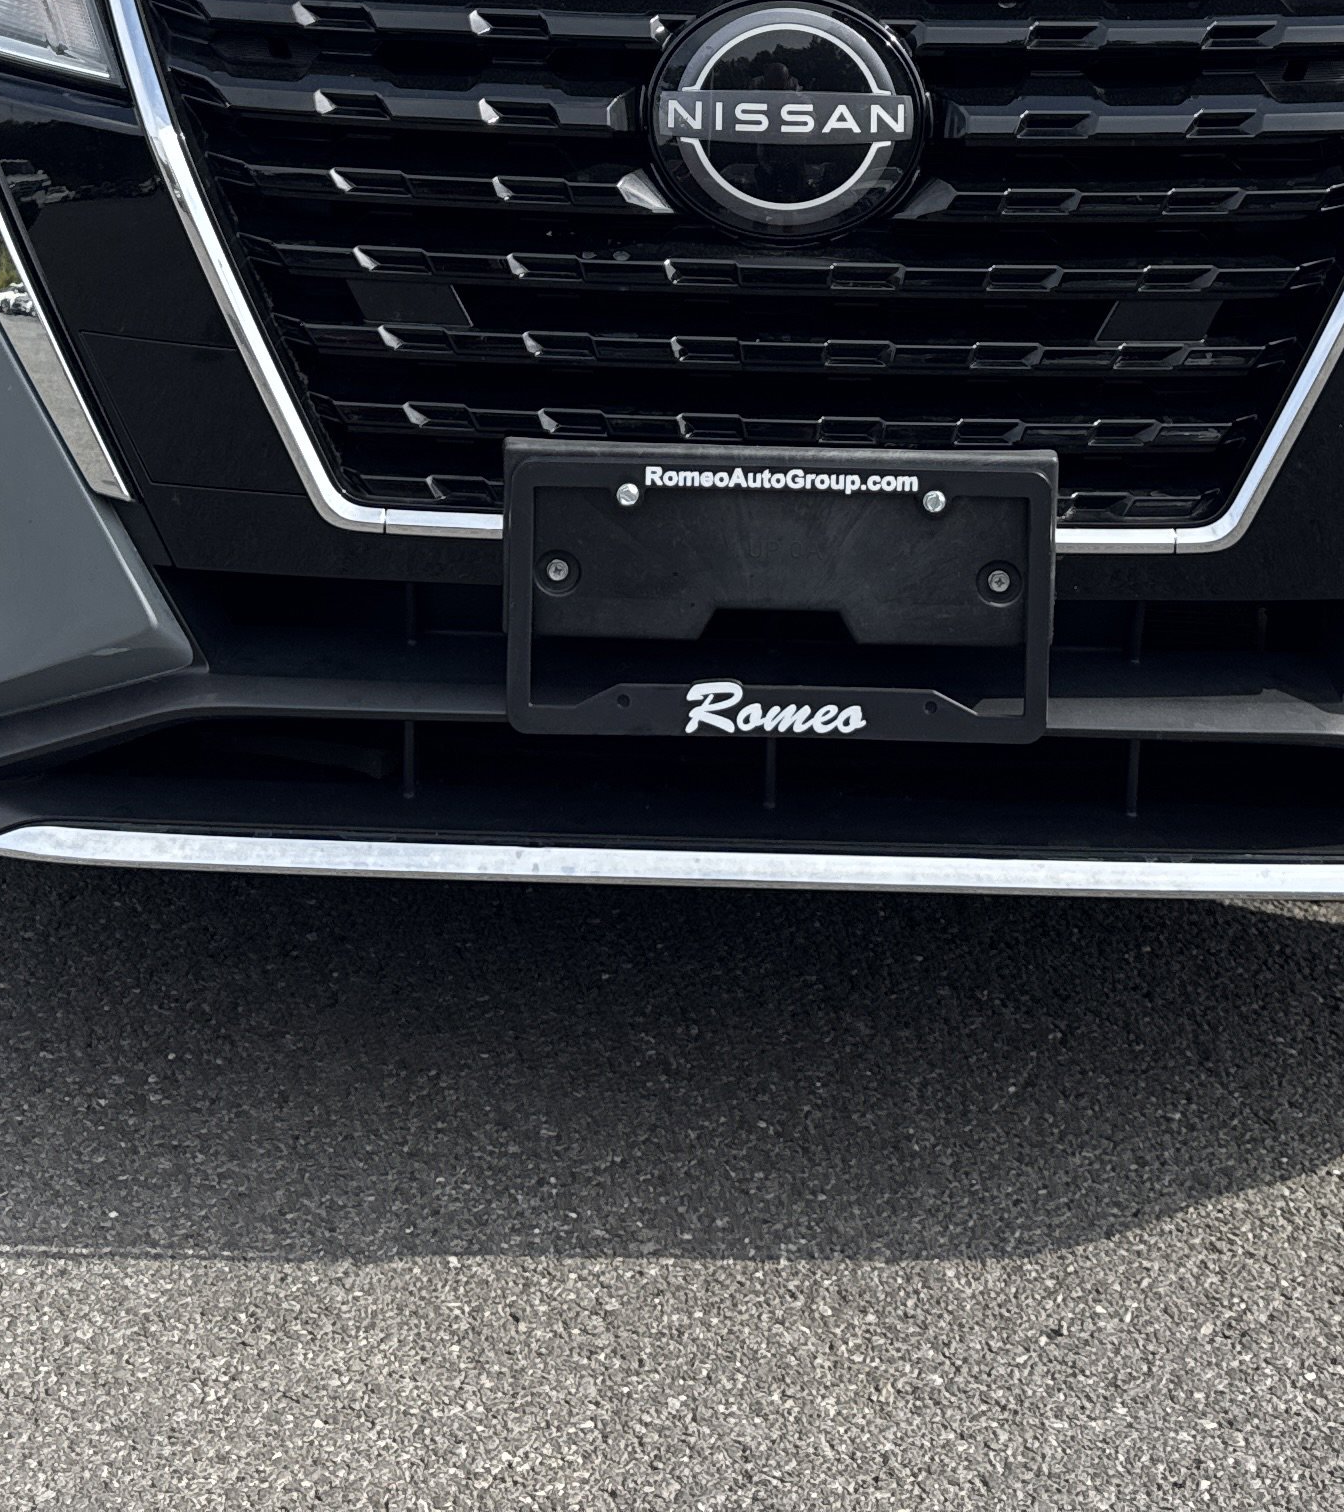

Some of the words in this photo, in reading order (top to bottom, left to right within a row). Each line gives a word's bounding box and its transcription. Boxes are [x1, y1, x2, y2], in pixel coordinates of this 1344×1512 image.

[667, 99, 905, 134] NISSAN
[644, 465, 919, 495] RomeoAutoGroup.com
[684, 681, 867, 735] Romeo
